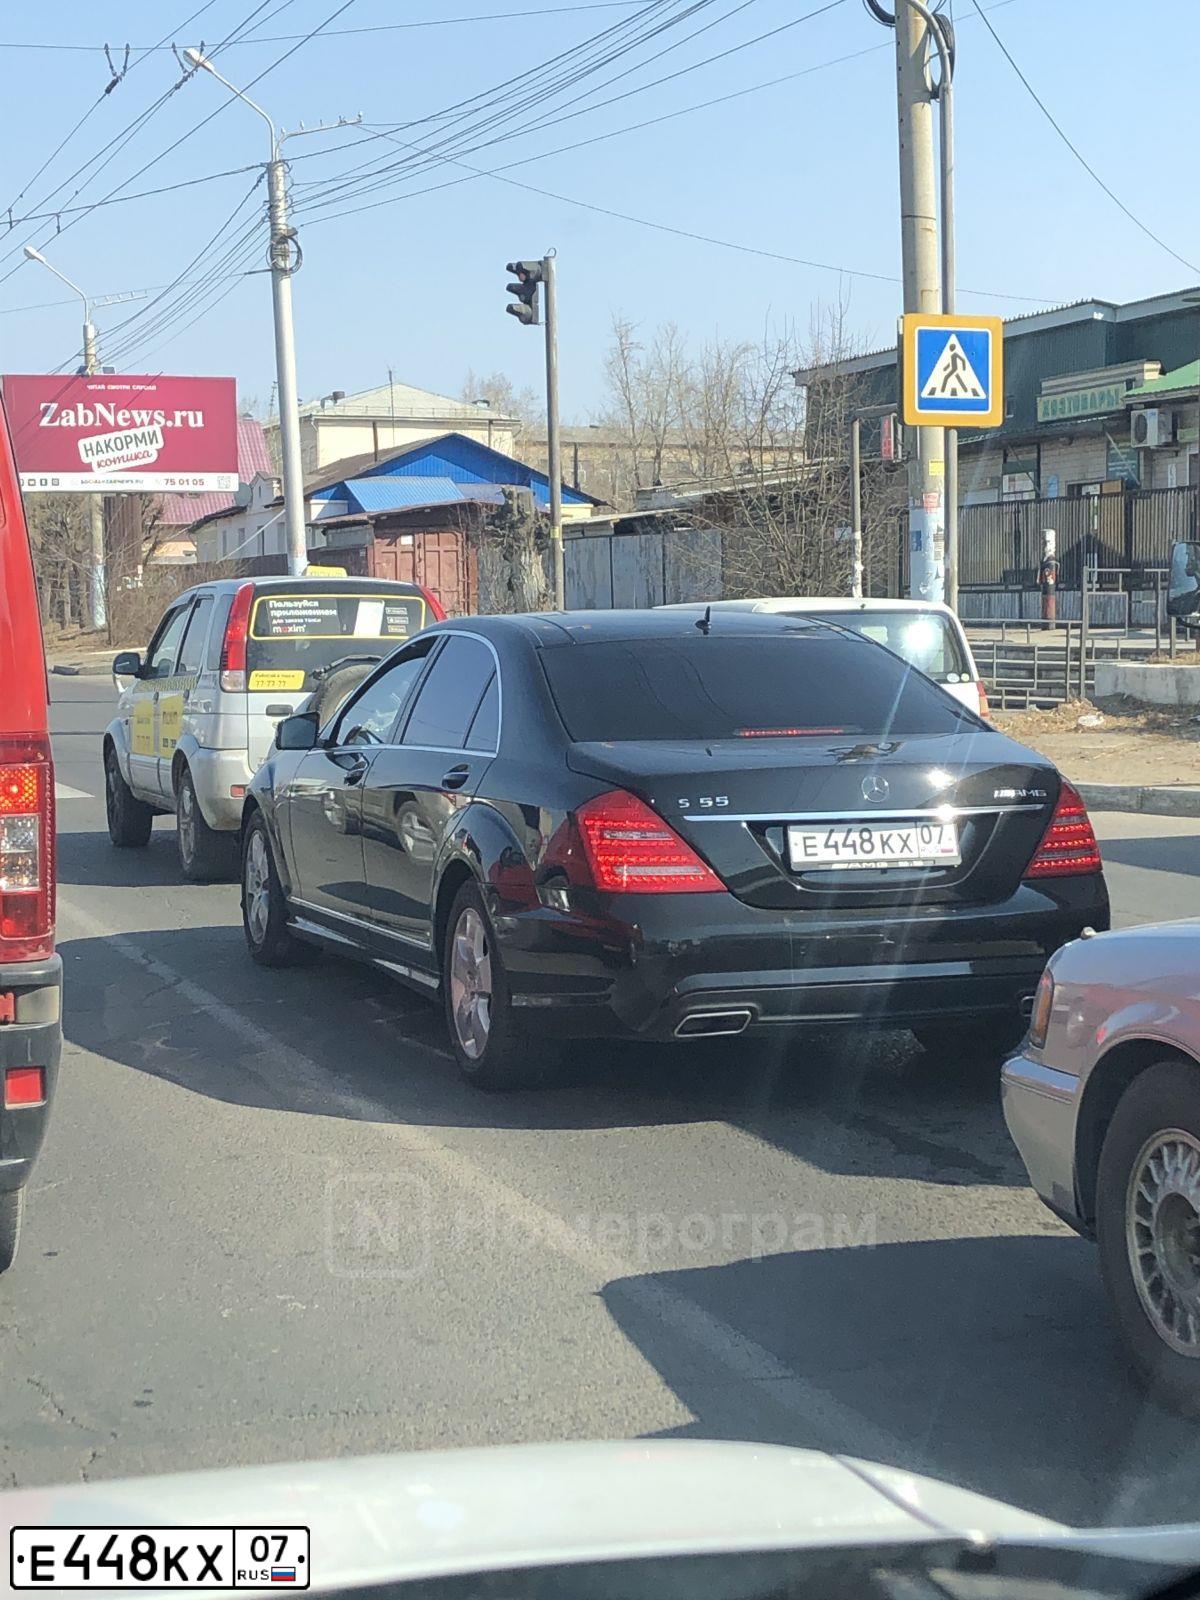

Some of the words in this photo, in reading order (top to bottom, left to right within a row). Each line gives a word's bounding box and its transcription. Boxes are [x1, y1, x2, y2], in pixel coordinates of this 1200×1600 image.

[39, 402, 205, 428] ZabNews.ru
[83, 429, 159, 459] НАКОРМИ
[96, 449, 153, 469] котика
[178, 478, 190, 486] 01
[192, 478, 205, 486] 05
[271, 609, 338, 617] приложением
[678, 798, 691, 809] S
[699, 795, 730, 808] 55
[920, 824, 944, 844] 07
